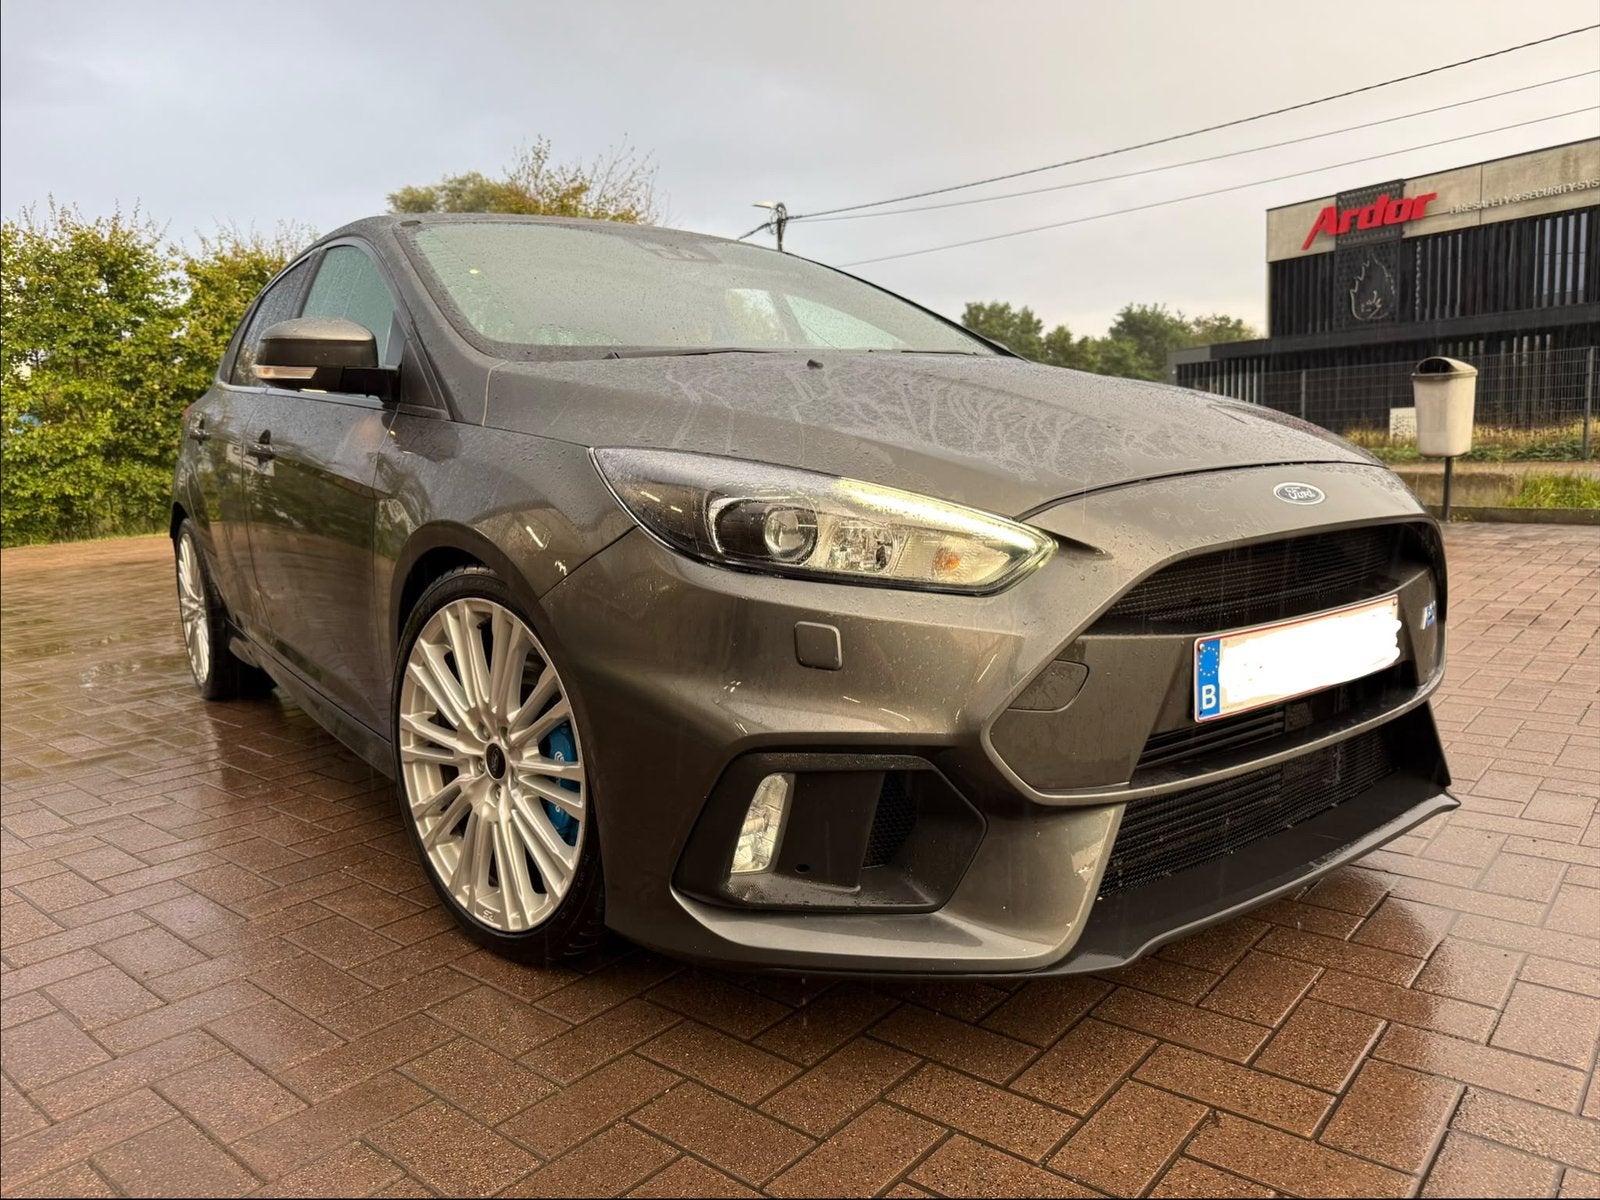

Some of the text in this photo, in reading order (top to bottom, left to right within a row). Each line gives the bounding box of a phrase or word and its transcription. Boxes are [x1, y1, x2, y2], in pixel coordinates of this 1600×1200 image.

[1521, 182, 1577, 201] SECURITY
[1301, 192, 1438, 251] Ardor
[1284, 486, 1316, 500] Ford
[1201, 684, 1217, 710] B
